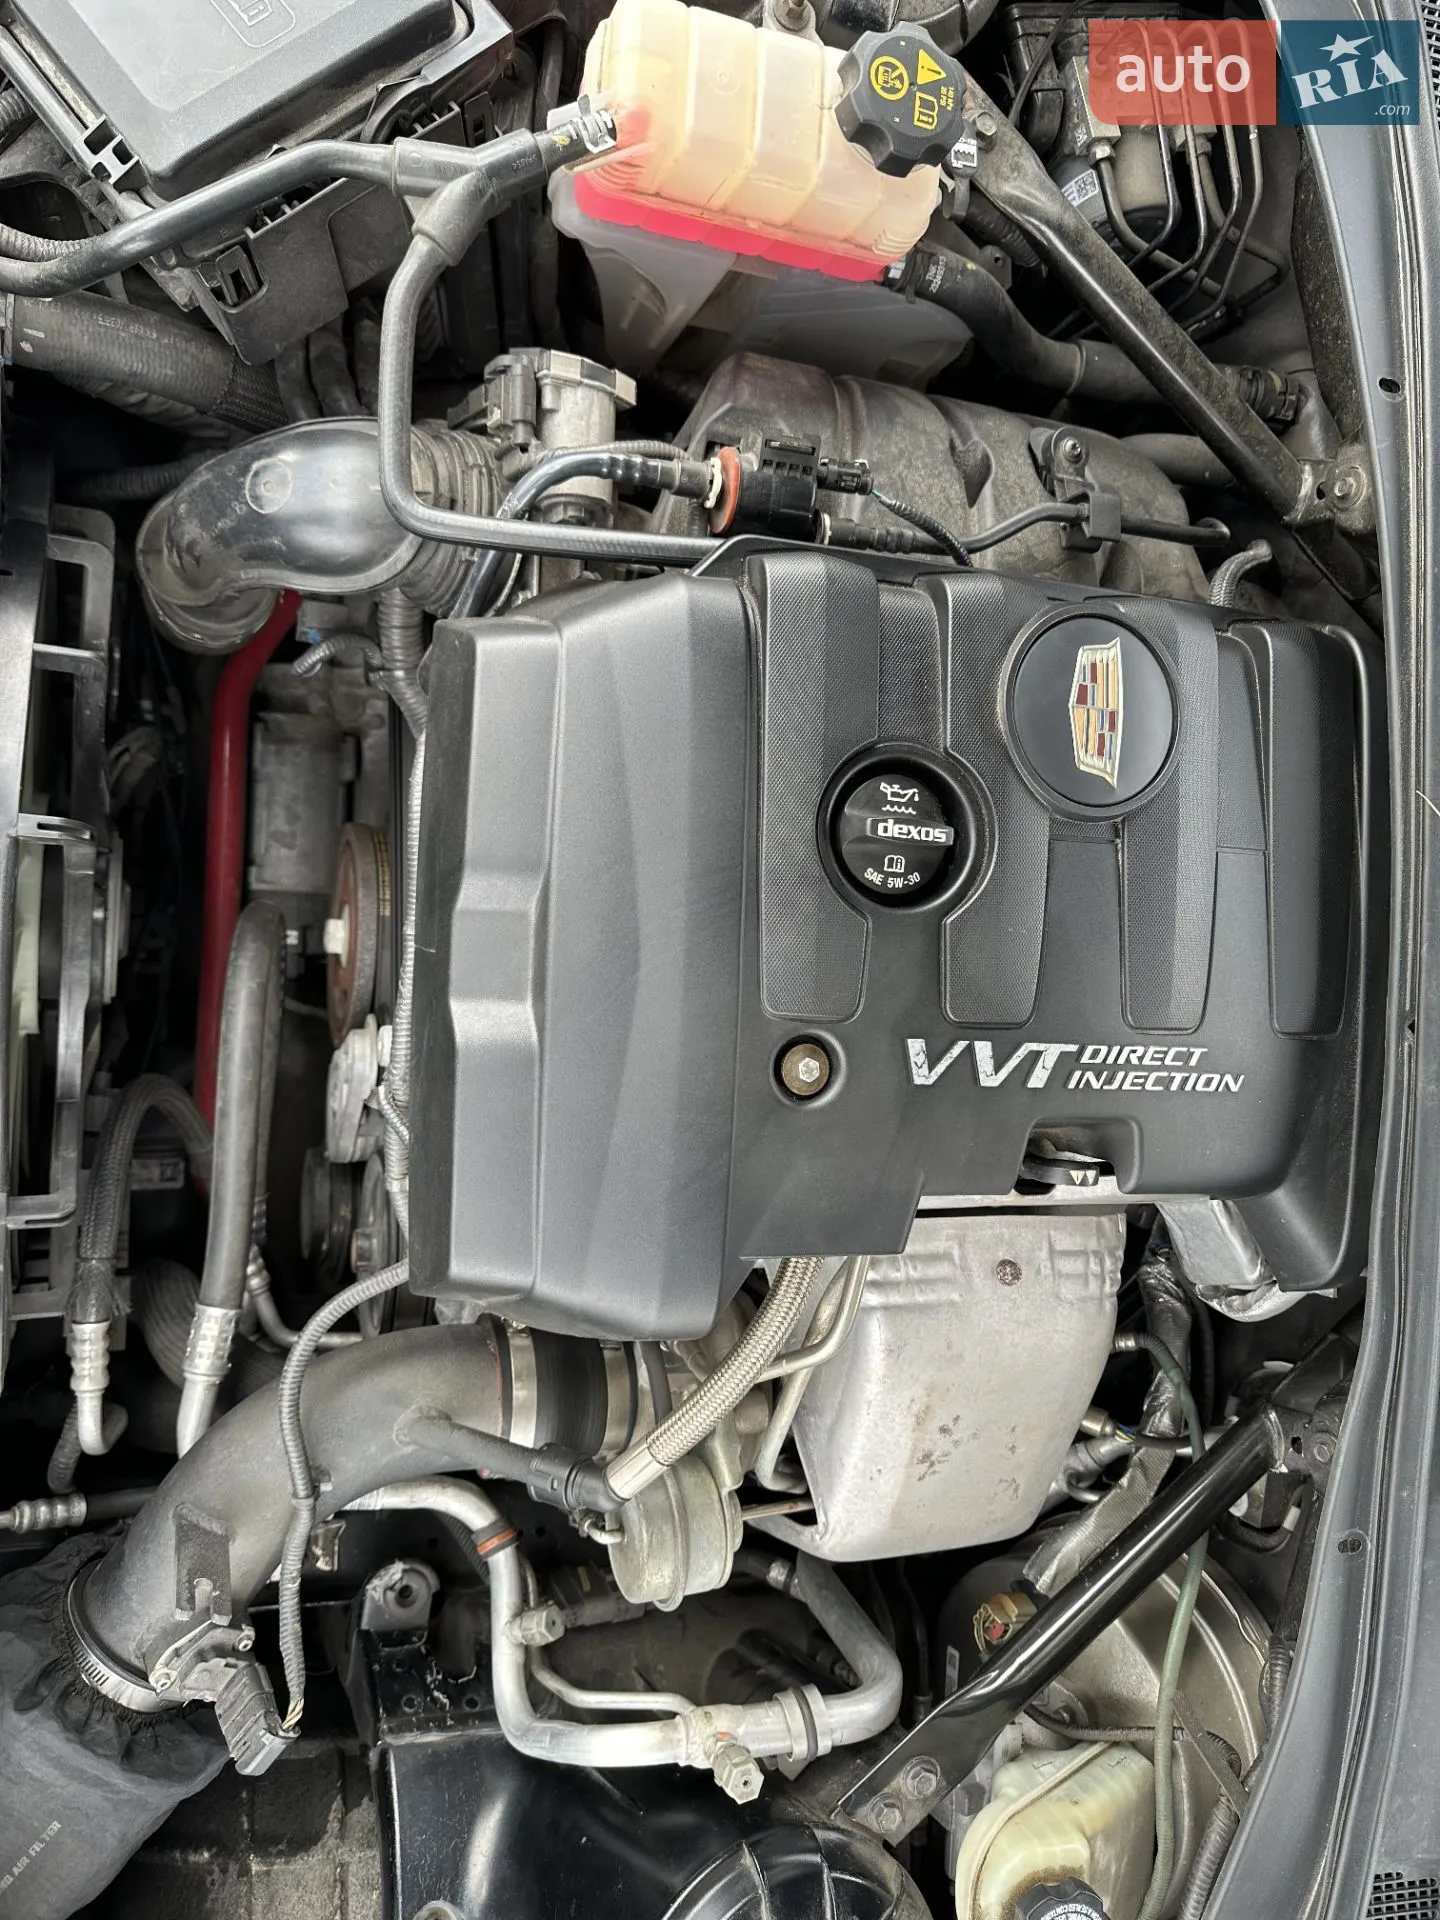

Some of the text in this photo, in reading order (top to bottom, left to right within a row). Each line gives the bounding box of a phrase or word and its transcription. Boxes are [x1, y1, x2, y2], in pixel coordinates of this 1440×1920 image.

[877, 819, 949, 843] dexos
[864, 867, 921, 889] SAE 5W-30
[905, 1038, 1080, 1089] VVT
[1079, 1044, 1209, 1067] DIRECT
[1067, 1070, 1245, 1093] INJECTION
[12, 1855, 31, 1877] AIR
[28, 1820, 62, 1857] FILTER
